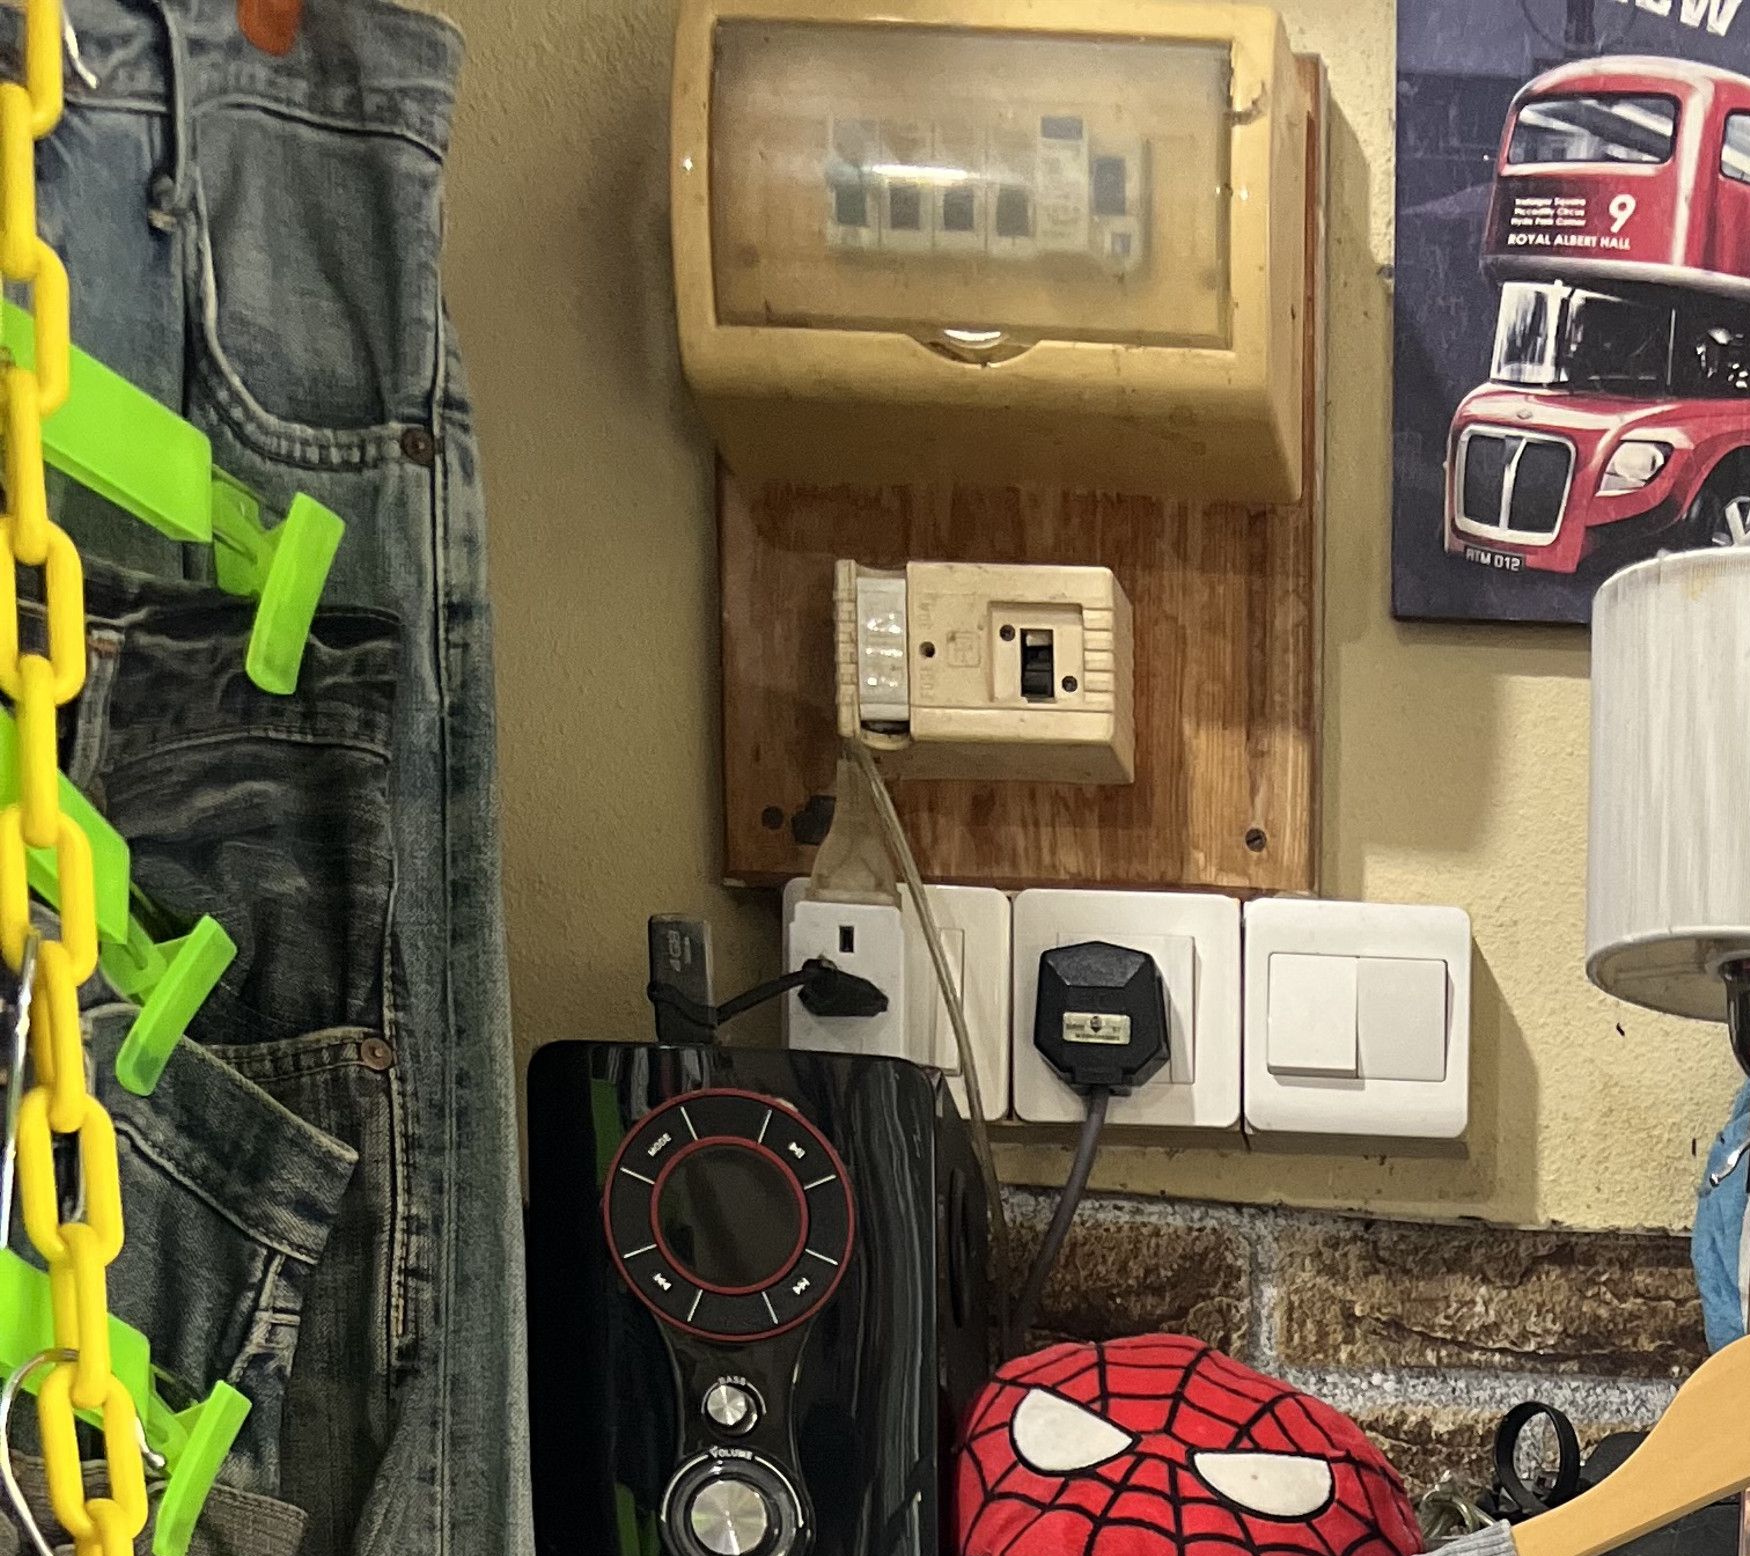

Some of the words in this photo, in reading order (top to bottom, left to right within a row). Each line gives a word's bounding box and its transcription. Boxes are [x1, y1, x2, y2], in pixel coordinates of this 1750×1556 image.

[1608, 194, 1636, 233] 9
[1507, 233, 1551, 246] ROYAL
[1553, 234, 1598, 248] ALBERT
[1599, 236, 1631, 251] HALL
[647, 1132, 672, 1157] MODE
[718, 1374, 747, 1386] BASS
[709, 1445, 753, 1461] VOLUME
